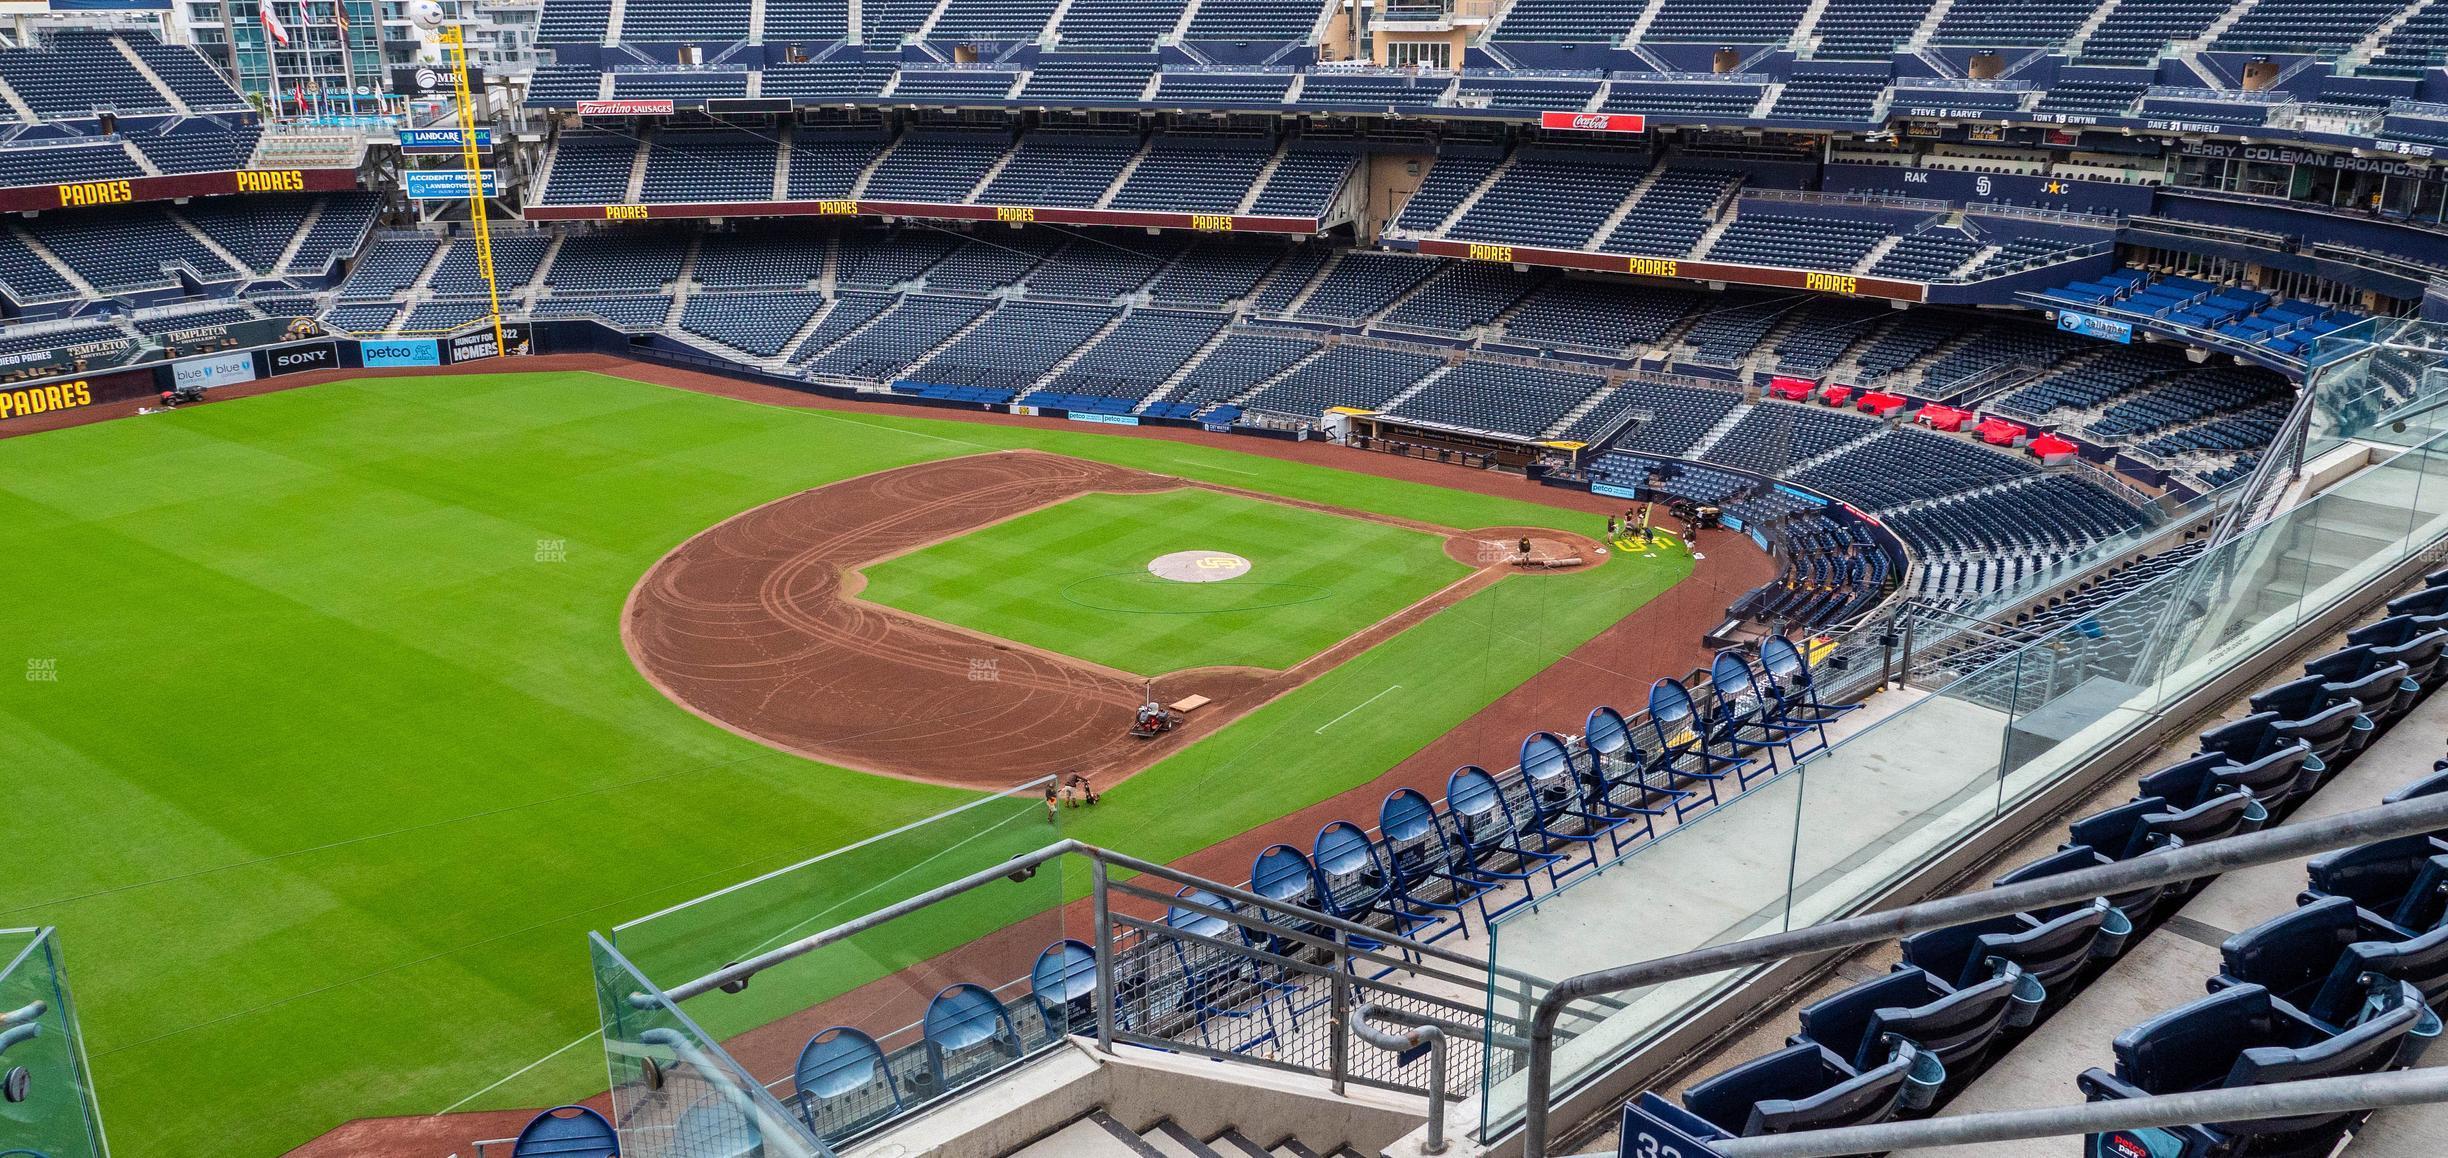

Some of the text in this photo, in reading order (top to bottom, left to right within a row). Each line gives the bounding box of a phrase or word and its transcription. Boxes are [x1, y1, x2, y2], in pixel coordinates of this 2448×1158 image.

[580, 103, 672, 114] Tarantino SAUSAGES
[1911, 108, 1982, 118] STEVE 6 GARVEY
[2032, 114, 2096, 125] TONY 19 GWYNN
[2147, 121, 2220, 133] DAVE 31 WINFIELD
[415, 132, 460, 141] LANDCARE
[2375, 141, 2435, 156] RANDY 35 JONES
[2182, 143, 2237, 157] JERRY
[2244, 147, 2327, 166] COLEMAN
[2333, 157, 2437, 180] BROADCAST
[236, 170, 304, 192] PADRES
[1904, 172, 1927, 183] RAK
[58, 180, 132, 207] PADRES
[606, 205, 648, 219] PADRES
[820, 201, 858, 214] PADRES
[997, 207, 1034, 221] PADRES
[1193, 215, 1232, 230] PADRES
[1470, 245, 1511, 262] PADRES
[1629, 257, 1677, 276] PADRES
[1806, 272, 1857, 293] PADRES
[2084, 318, 2128, 334] Gallagher
[168, 326, 228, 342] TEMPLETON
[454, 332, 494, 347] HUNGRY FOR
[502, 329, 517, 339] 322
[66, 340, 130, 356] TEMPLETON
[366, 345, 411, 361] petco
[453, 341, 498, 362] HOMERS
[22, 351, 52, 363] PADRES
[277, 350, 328, 367] SONY
[177, 369, 202, 380] blue
[216, 363, 240, 374] blue
[0, 381, 92, 419] PADRES
[1593, 485, 1613, 493] petco
[2113, 1135, 2146, 1157] petco
[2119, 1143, 2140, 1158] park
